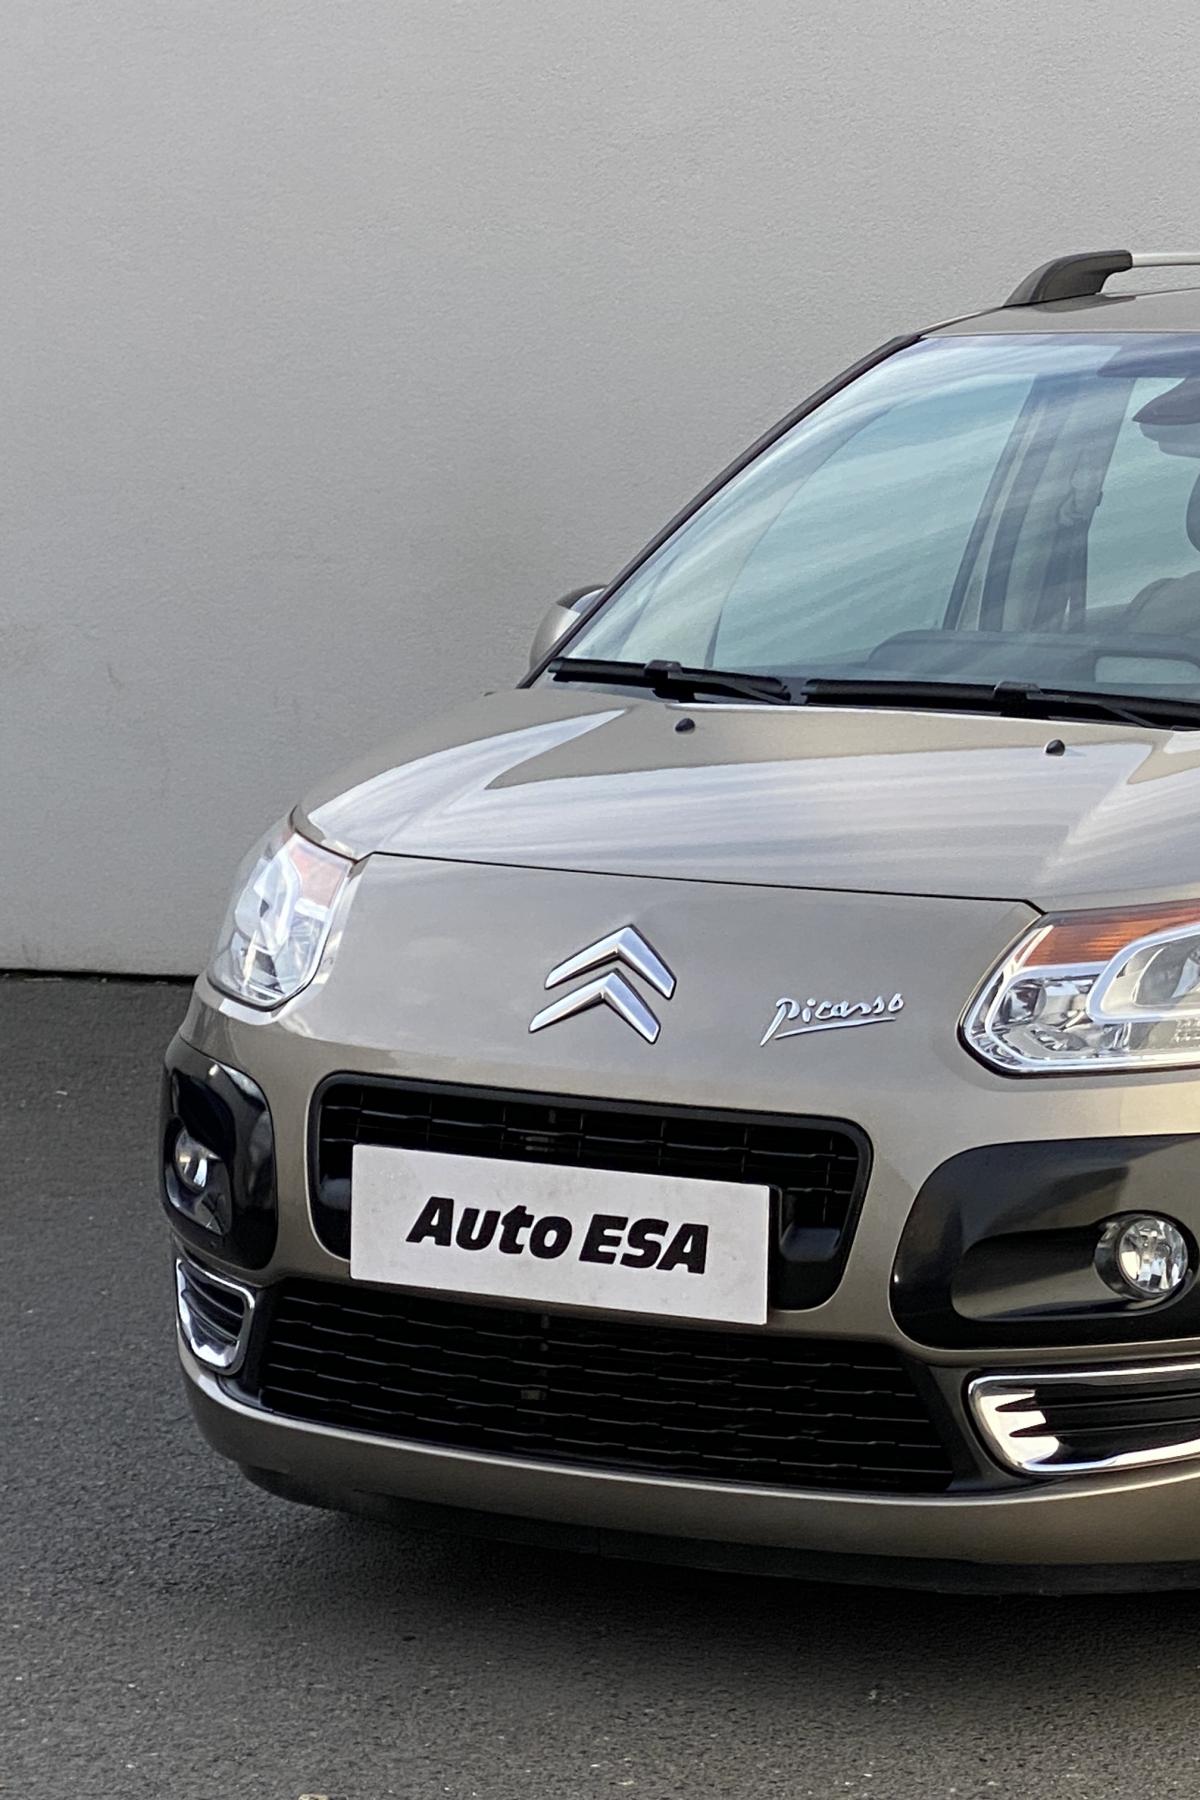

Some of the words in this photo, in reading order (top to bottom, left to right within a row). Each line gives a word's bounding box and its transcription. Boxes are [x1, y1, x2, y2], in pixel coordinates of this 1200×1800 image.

[760, 993, 904, 1047] Picasso
[406, 1197, 573, 1260] Auto
[579, 1214, 709, 1275] ESA
